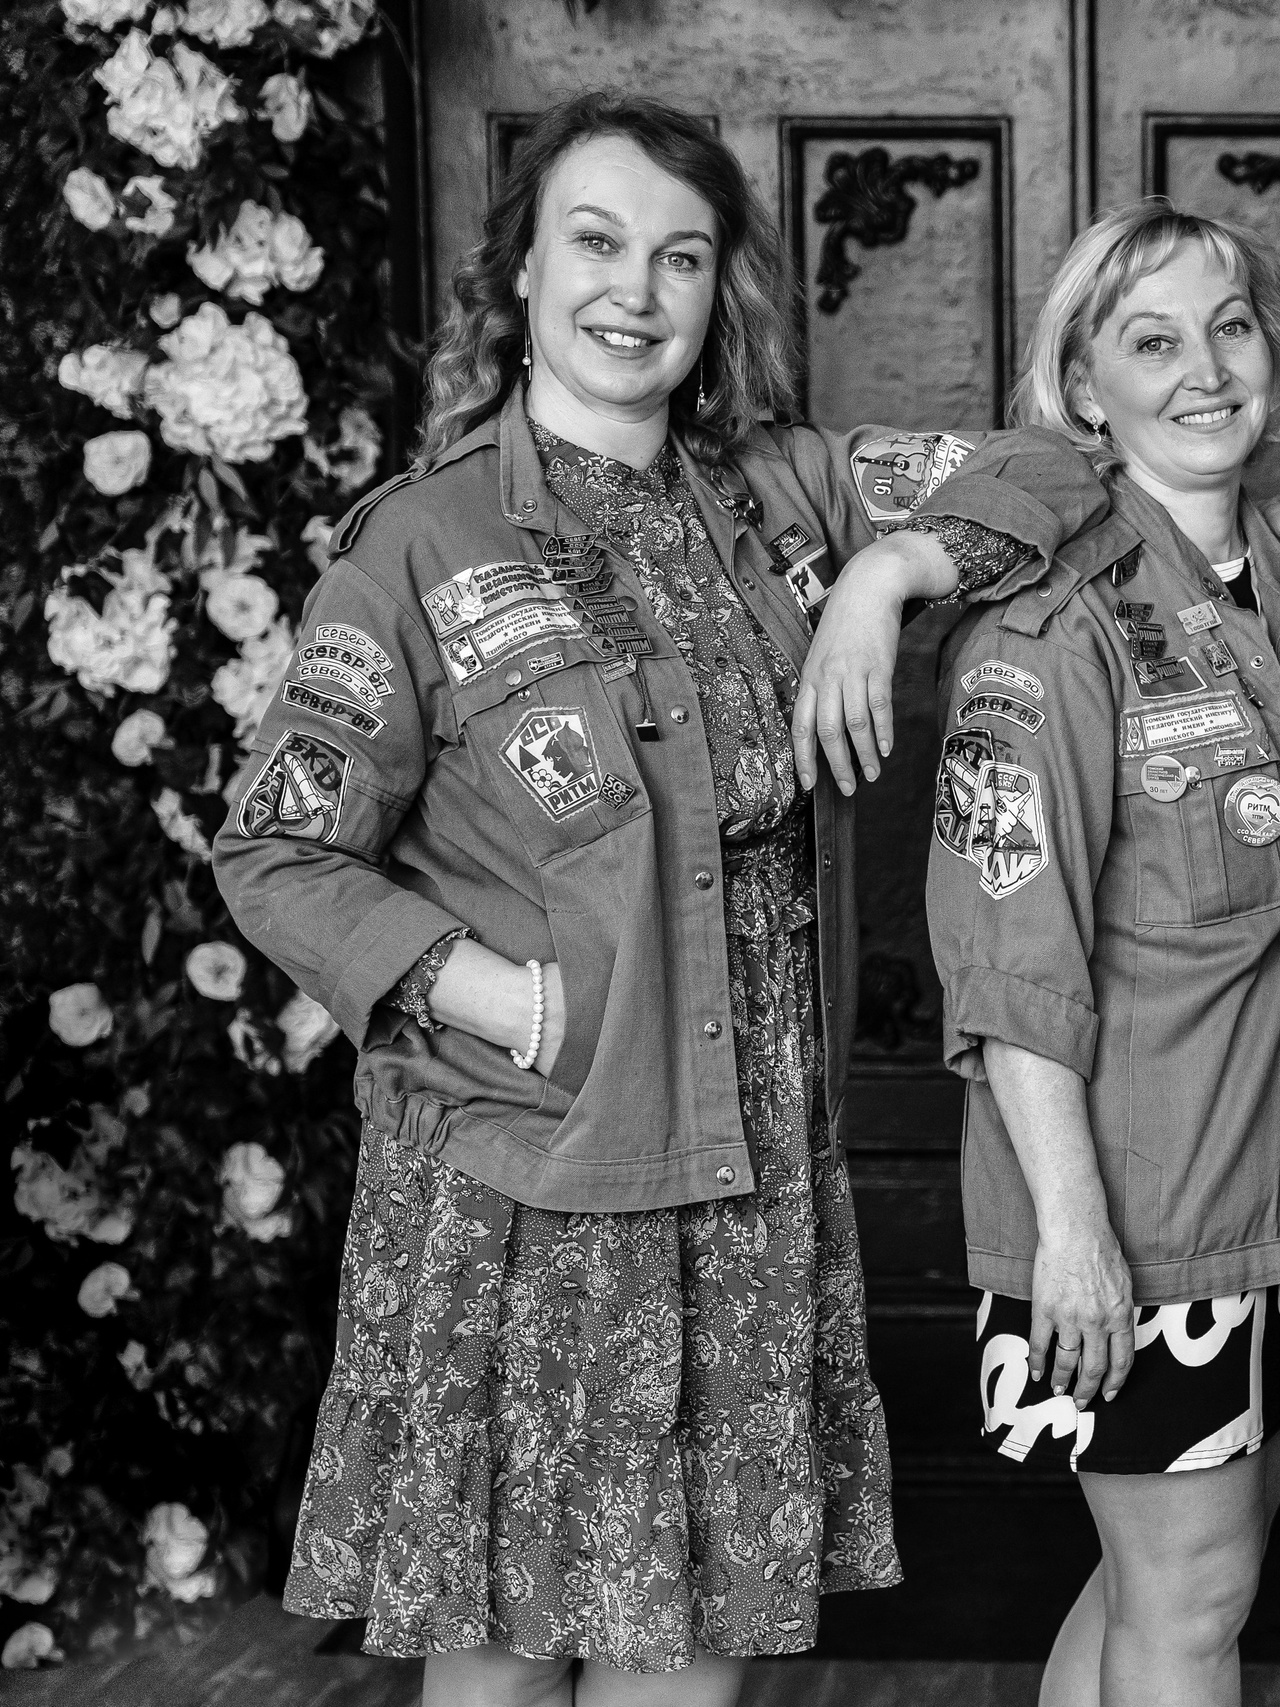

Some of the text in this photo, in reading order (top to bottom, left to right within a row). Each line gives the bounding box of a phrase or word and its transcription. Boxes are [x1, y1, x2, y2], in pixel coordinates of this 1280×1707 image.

[873, 477, 893, 495] 91
[513, 619, 541, 633] ИМЕНИ
[485, 631, 528, 657] ЛЕНИНСКОГО
[1146, 714, 1203, 731] ПЕДАГОГИЧЕСКИЙ
[1181, 722, 1205, 731] ИМЕНИ
[1150, 731, 1195, 745] ЛЕНИНСКОГО
[547, 775, 597, 811] РИТМ
[1247, 802, 1270, 812] РИТМ
[1243, 835, 1265, 843] СЕВЕР
